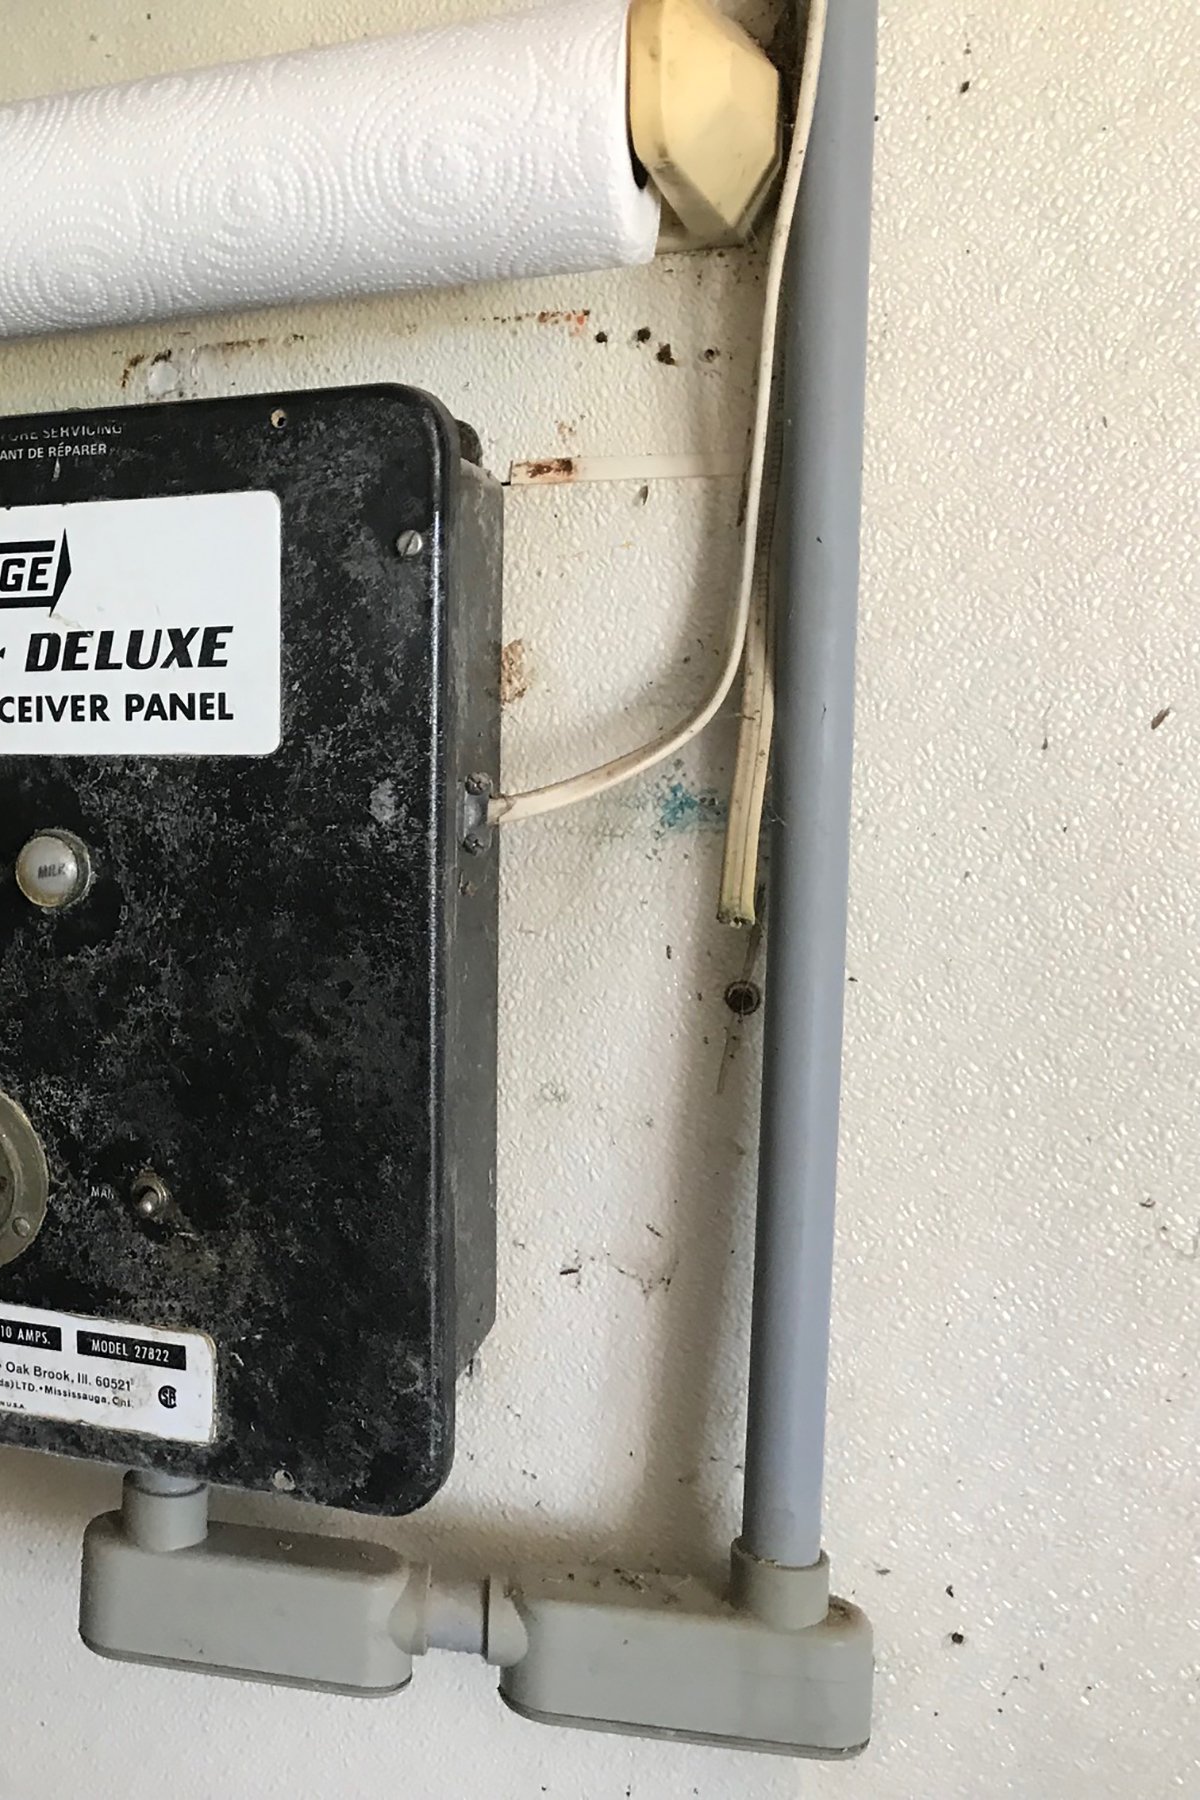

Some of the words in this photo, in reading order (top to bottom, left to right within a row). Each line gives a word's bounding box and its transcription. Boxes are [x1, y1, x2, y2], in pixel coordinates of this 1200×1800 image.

[28, 447, 44, 459] DE
[48, 441, 107, 457] RÉPARER
[24, 625, 234, 673] DELUXE
[125, 692, 234, 721] PANEL
[0, 1324, 12, 1339] 10
[17, 1328, 51, 1345] AMPS.
[91, 1339, 128, 1357] MODEL
[134, 1346, 169, 1363] 27822
[5, 1361, 30, 1375] Oak
[34, 1365, 74, 1384] Brook,
[77, 1373, 91, 1386] Ill.
[95, 1375, 132, 1392] 60521
